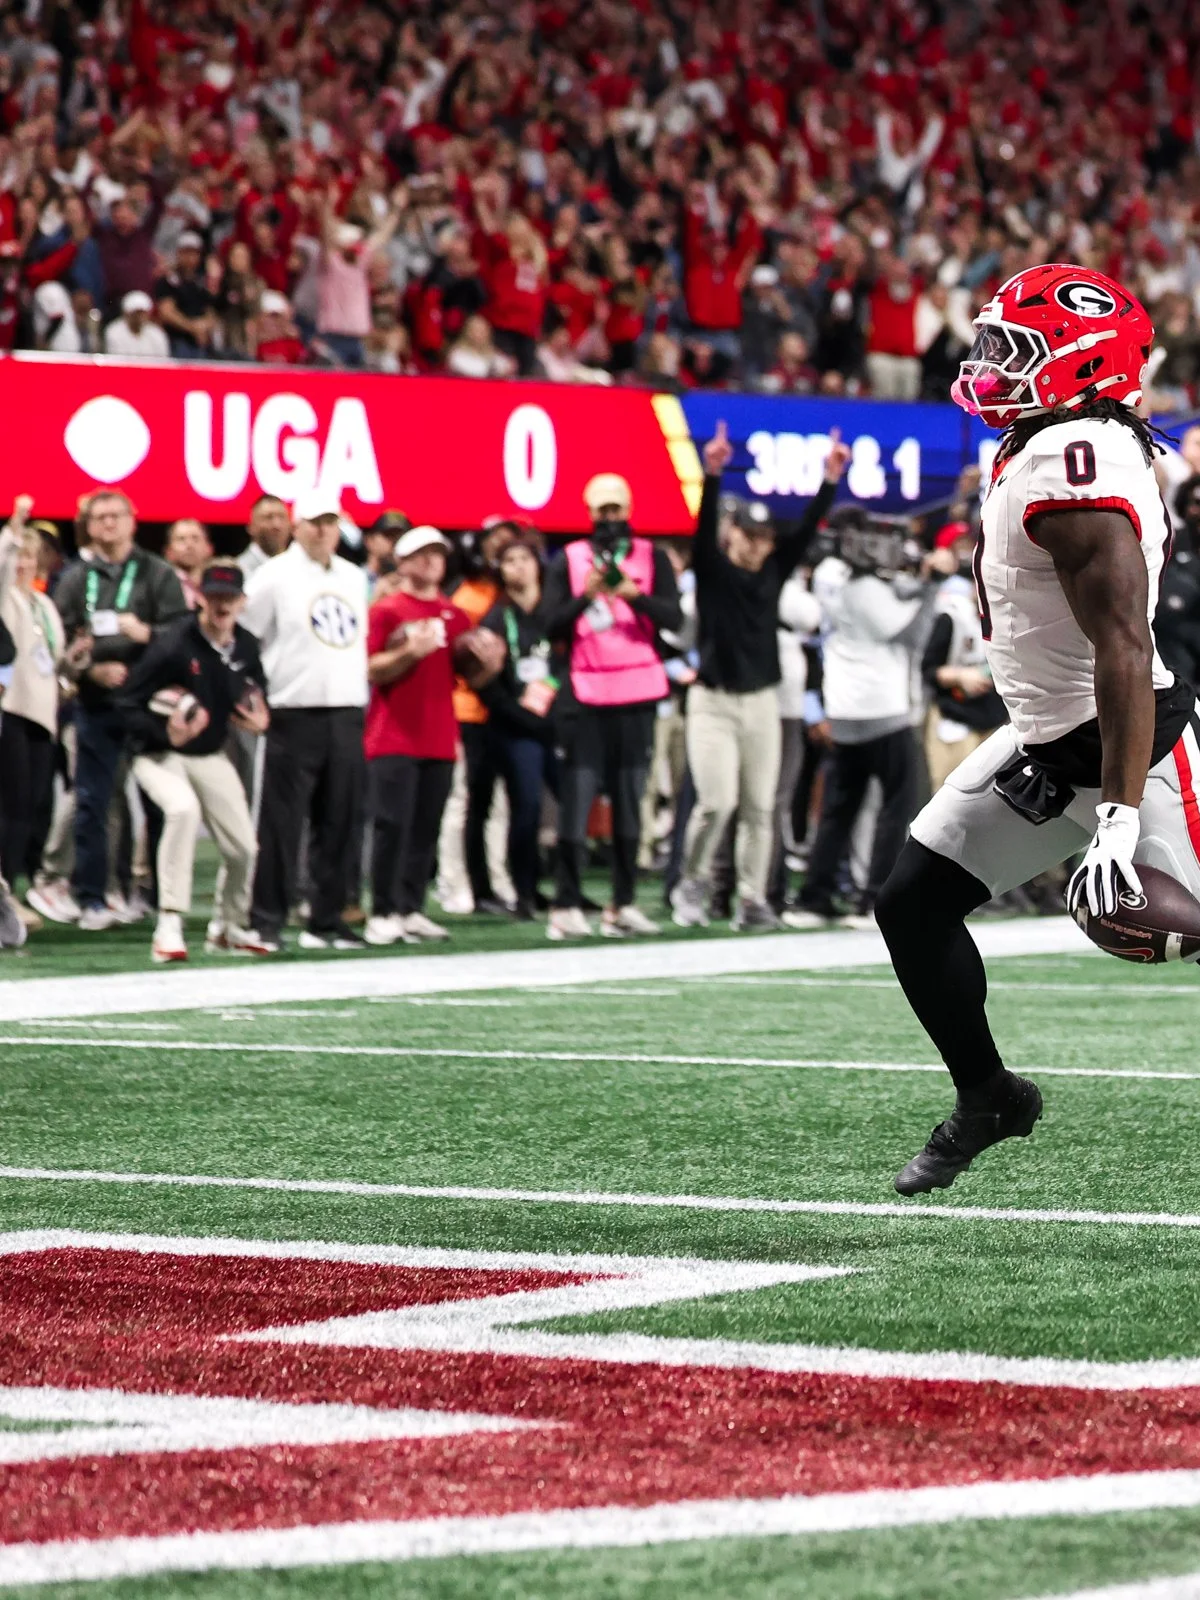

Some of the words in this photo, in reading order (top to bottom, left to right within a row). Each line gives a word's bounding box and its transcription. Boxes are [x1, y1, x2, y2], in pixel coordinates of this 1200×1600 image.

[1054, 280, 1117, 318] G
[183, 391, 384, 504] UGA
[503, 403, 558, 510] 0
[847, 435, 888, 499] &
[893, 437, 921, 501] 1
[1064, 440, 1097, 487] 0
